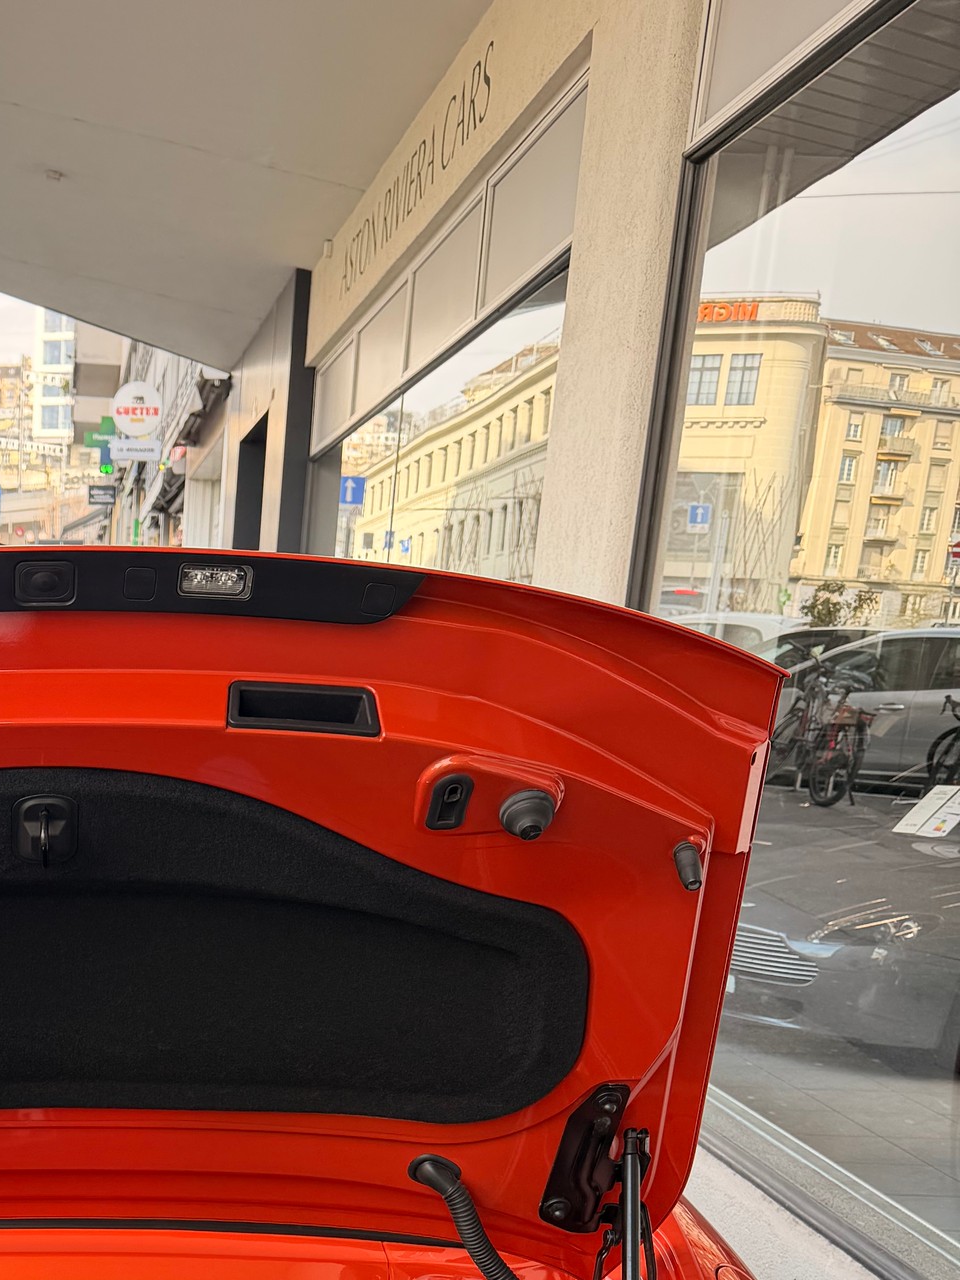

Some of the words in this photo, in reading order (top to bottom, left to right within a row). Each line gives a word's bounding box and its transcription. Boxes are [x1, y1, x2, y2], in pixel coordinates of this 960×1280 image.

[339, 201, 381, 301] ASTON
[381, 123, 436, 250] RIVIERA
[441, 40, 495, 171] CARS
